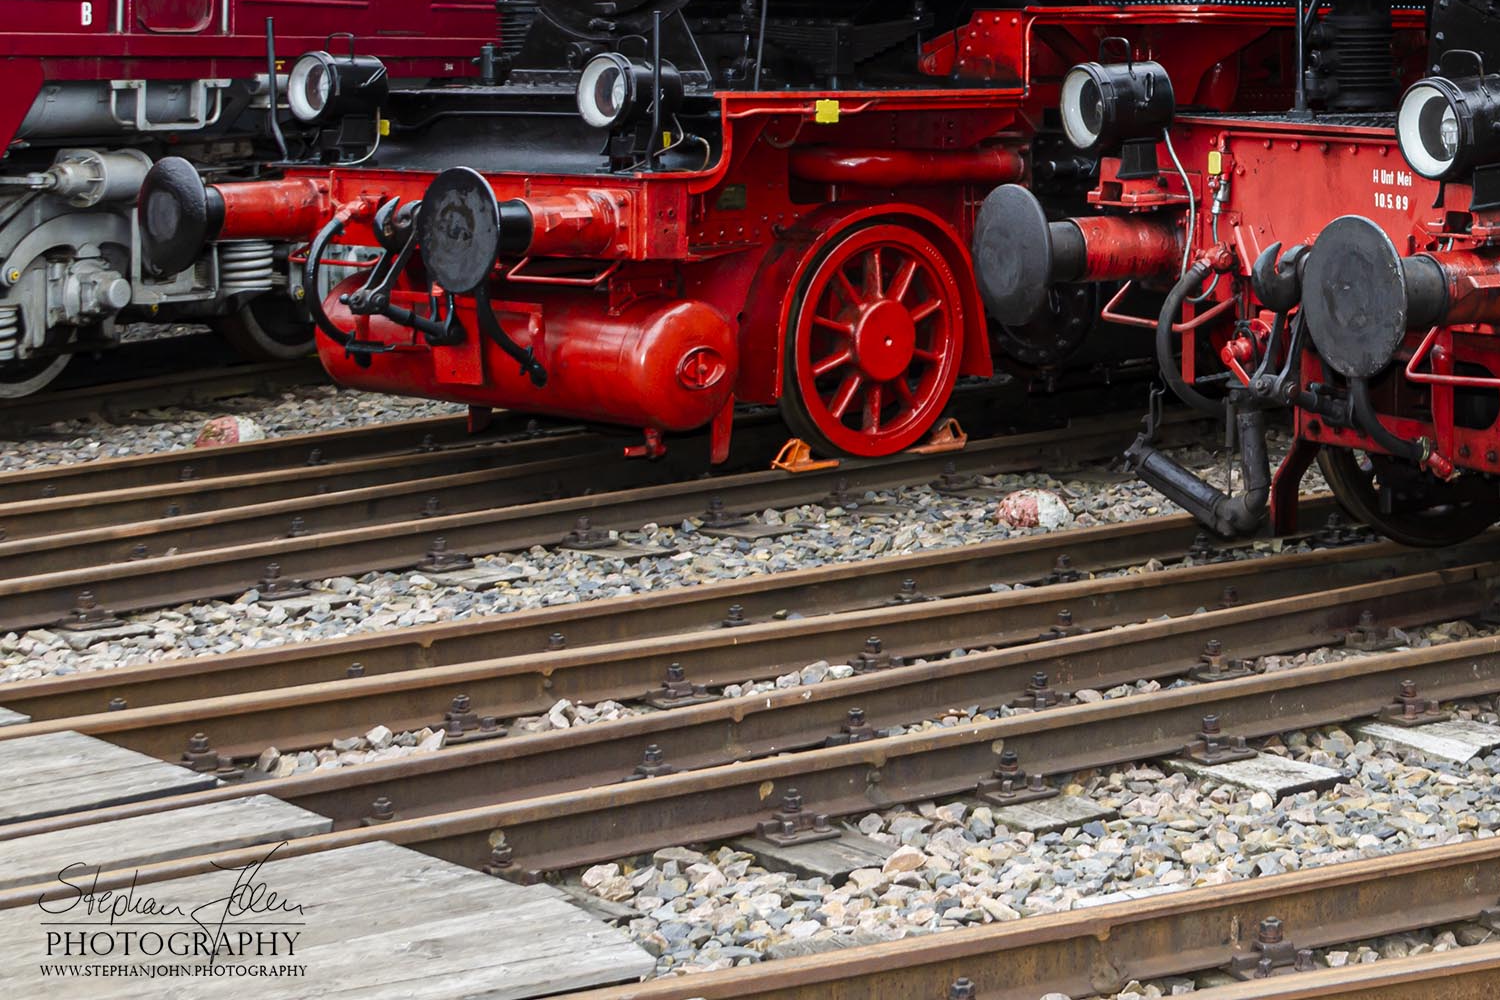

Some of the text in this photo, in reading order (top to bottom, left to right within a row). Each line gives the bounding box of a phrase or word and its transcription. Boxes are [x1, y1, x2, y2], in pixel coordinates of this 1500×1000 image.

[80, 1, 92, 26] B
[1372, 168, 1412, 187] H Unt Mei
